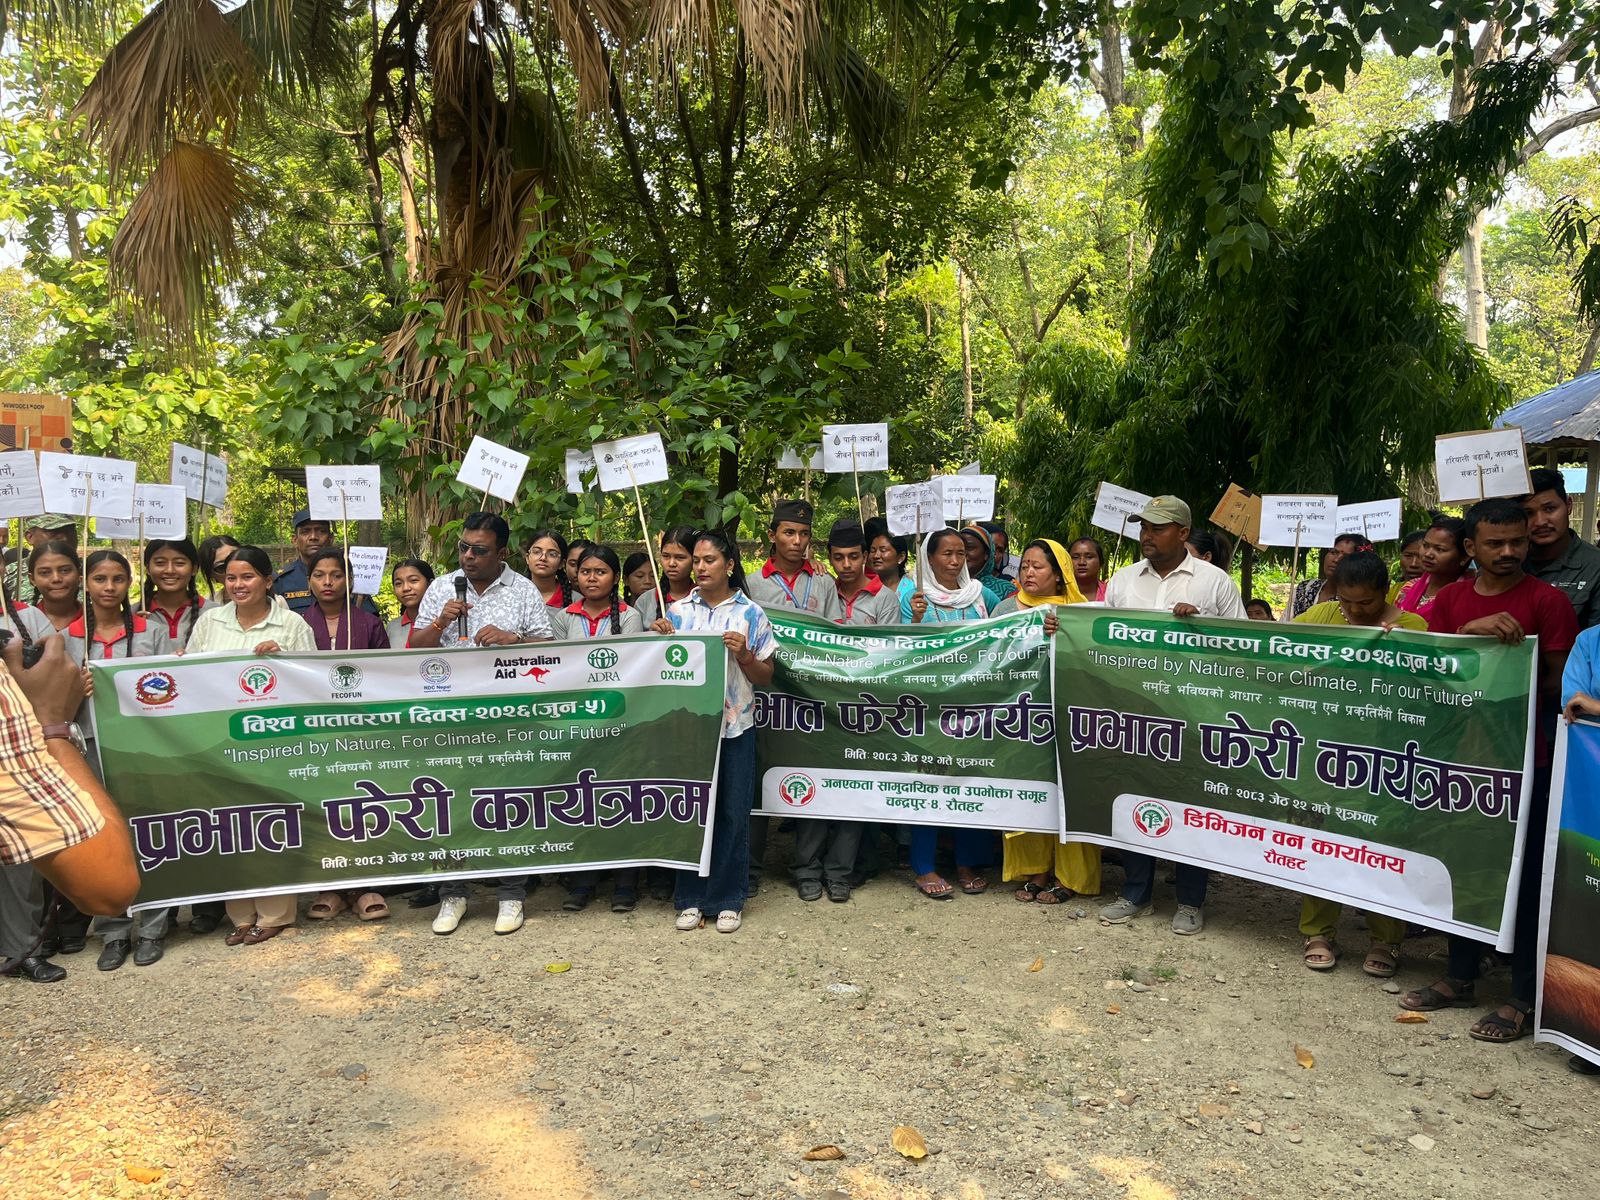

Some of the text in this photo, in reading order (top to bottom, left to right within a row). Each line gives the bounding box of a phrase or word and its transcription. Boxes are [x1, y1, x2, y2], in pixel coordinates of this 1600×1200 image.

[803, 629, 889, 648] वातावरण
[1108, 621, 1157, 643] विश्व
[1163, 630, 1261, 655] वातावरण
[494, 654, 562, 668] Australian
[803, 651, 820, 667] by
[825, 653, 877, 669] Nature,
[883, 658, 907, 667] For
[912, 652, 972, 665] Climate,
[978, 649, 1003, 662] For
[1007, 649, 1033, 661] our
[494, 668, 517, 680] Aid
[587, 670, 621, 683] ADRA
[660, 669, 694, 681] OXFAM
[860, 675, 889, 685] आधार
[902, 674, 937, 687] जलवायु
[942, 673, 956, 687] एवं
[1008, 670, 1039, 681] विकास
[1088, 649, 1483, 708] "Inspired by Nature, For Climate, For our Future"
[331, 691, 362, 700] FECOFUN
[1177, 683, 1224, 699] भविष्यको
[1228, 689, 1263, 704] आधार
[1278, 695, 1317, 715] जलवायु
[1322, 701, 1339, 716] एवं
[1345, 703, 1393, 722] प्रकृतिमैत्री
[1398, 709, 1427, 727] विकास
[242, 715, 297, 734] विश्व
[303, 711, 402, 729] वातावरण
[838, 691, 928, 737] फेरी
[224, 722, 628, 764] "Inspired by Nature, For Climate, For our Future"
[325, 759, 373, 774] भविष्यको
[377, 758, 411, 771] आधार
[425, 754, 463, 769] जलवायु
[468, 753, 483, 767] एवं
[488, 750, 535, 767] प्रकृतिमैत्री
[540, 749, 571, 762] विकास
[872, 752, 898, 762] २०८३
[901, 752, 918, 763] जेठ
[921, 755, 934, 764] २२
[937, 755, 953, 766] गते
[956, 757, 995, 768] शुक्रवार
[1068, 705, 1524, 823] प्रभात फेरी कार्यक्रम
[821, 778, 873, 791] जनएकता
[877, 780, 939, 795] सामुदायिक
[943, 784, 960, 796] वन
[964, 784, 1013, 800] उपभोक्ता
[1016, 789, 1048, 804] समूह
[945, 797, 984, 813] रौतहट
[1236, 787, 1265, 803] २०८३
[1269, 792, 1290, 808] जेठ
[1292, 799, 1307, 810] २२
[1311, 802, 1331, 816] गते
[1335, 807, 1378, 826] शुक्रवार
[130, 768, 714, 873] प्रभात फेरी कार्यक्रम
[1183, 807, 1406, 874] डिभिजन वन कार्यालय
[354, 856, 384, 867] २०८३
[388, 851, 408, 864] जेठ
[411, 852, 425, 862] २२
[428, 848, 447, 861] गते
[1263, 848, 1307, 871] रौतहट
